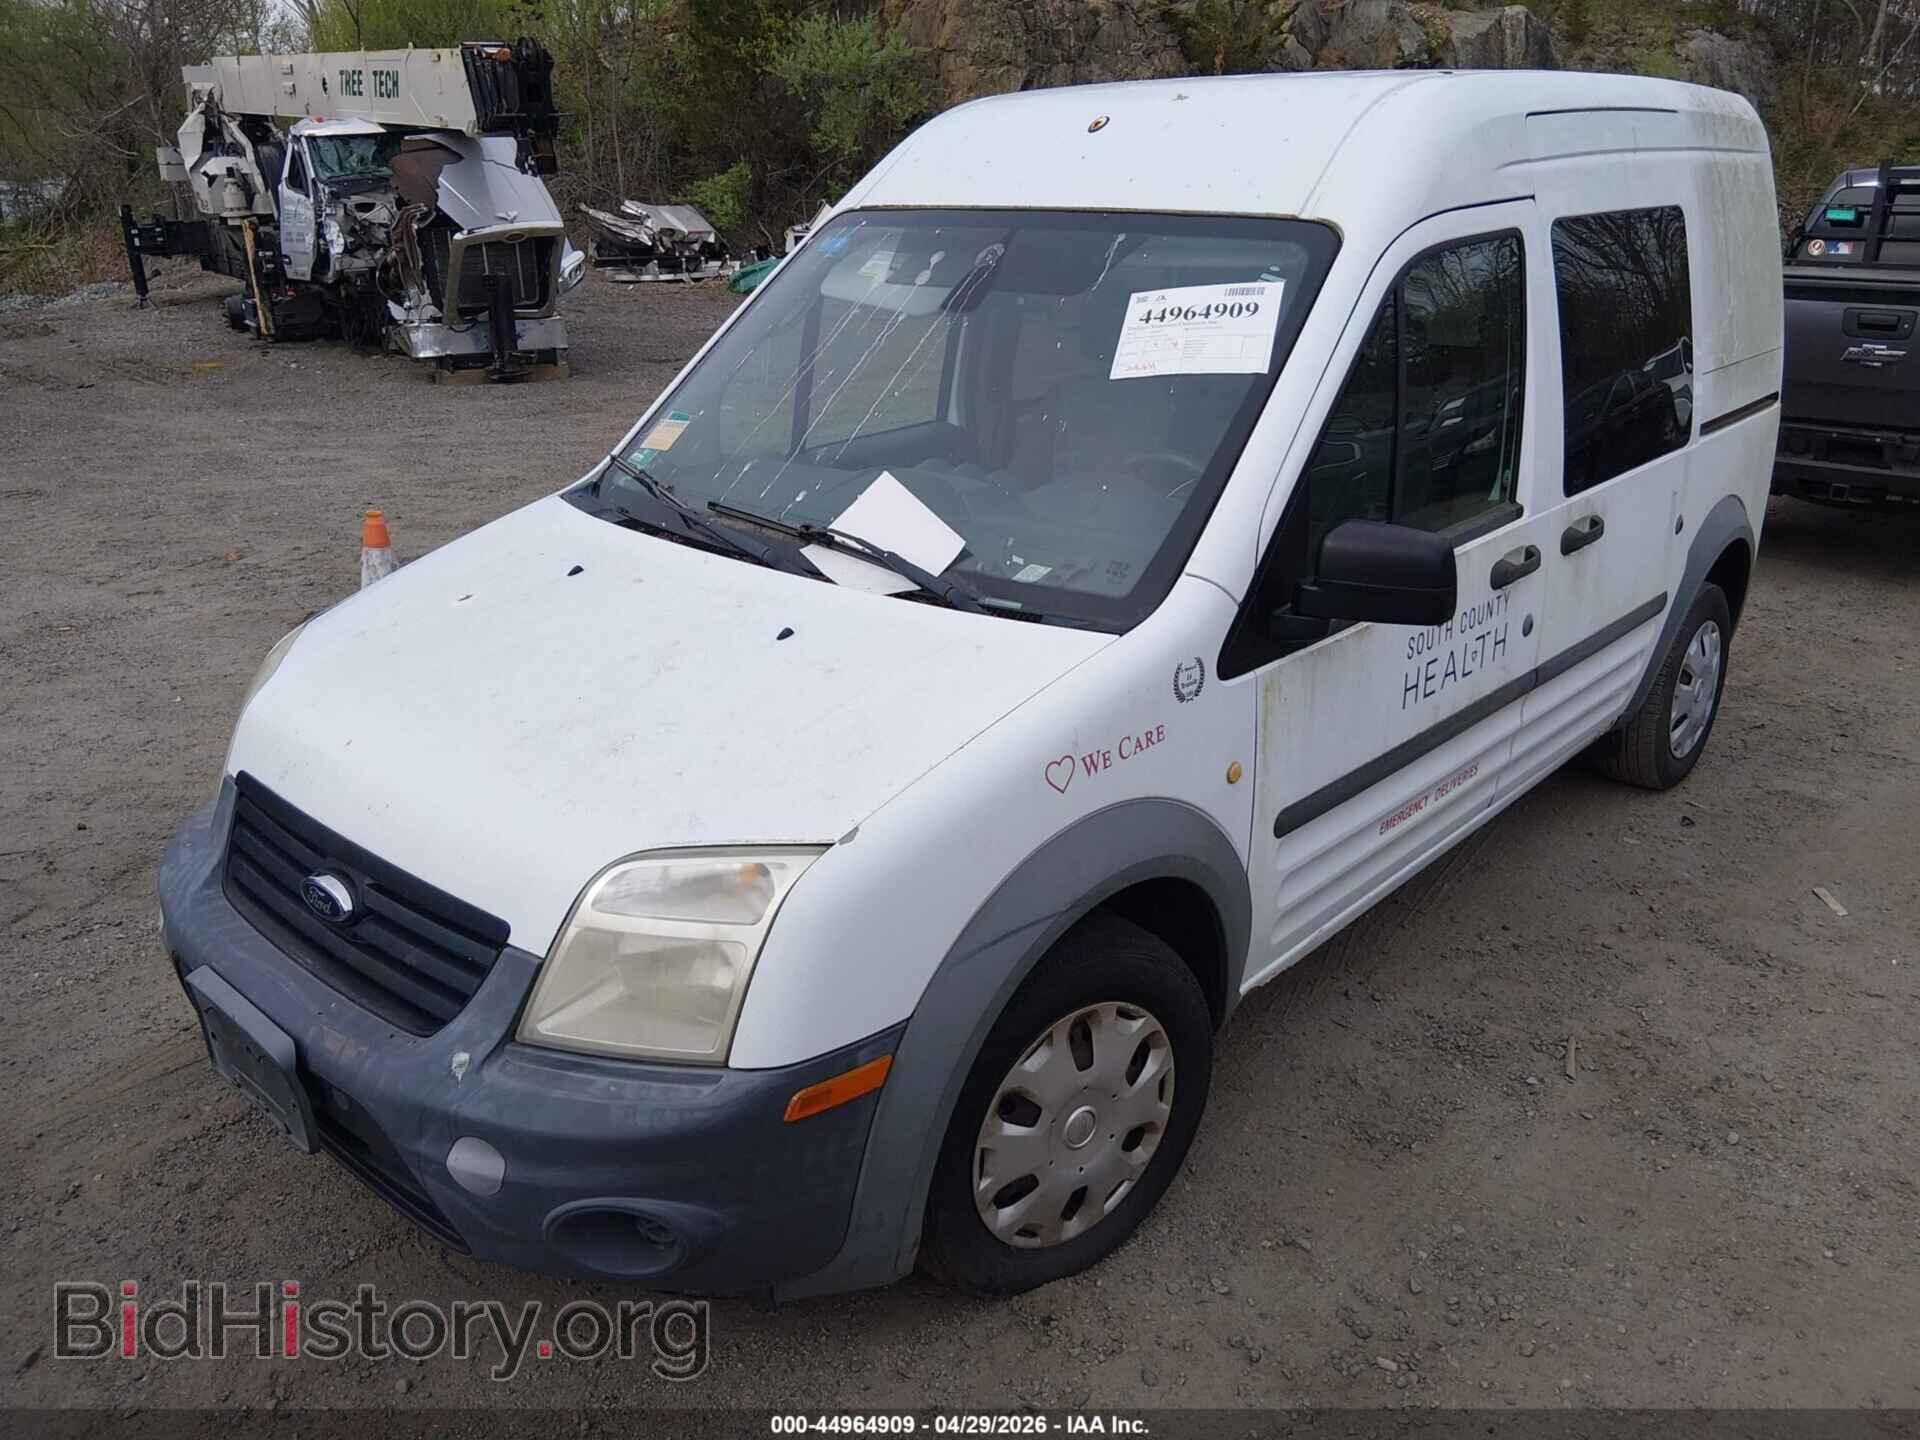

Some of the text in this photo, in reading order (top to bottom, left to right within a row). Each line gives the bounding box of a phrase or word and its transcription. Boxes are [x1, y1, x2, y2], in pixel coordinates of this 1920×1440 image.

[339, 69, 400, 99] TREE TECH
[1138, 301, 1260, 324] 44964909
[1460, 589, 1511, 634] COUNTY
[1402, 621, 1508, 710] HEALTH
[1379, 794, 1428, 836] EMERGENCY
